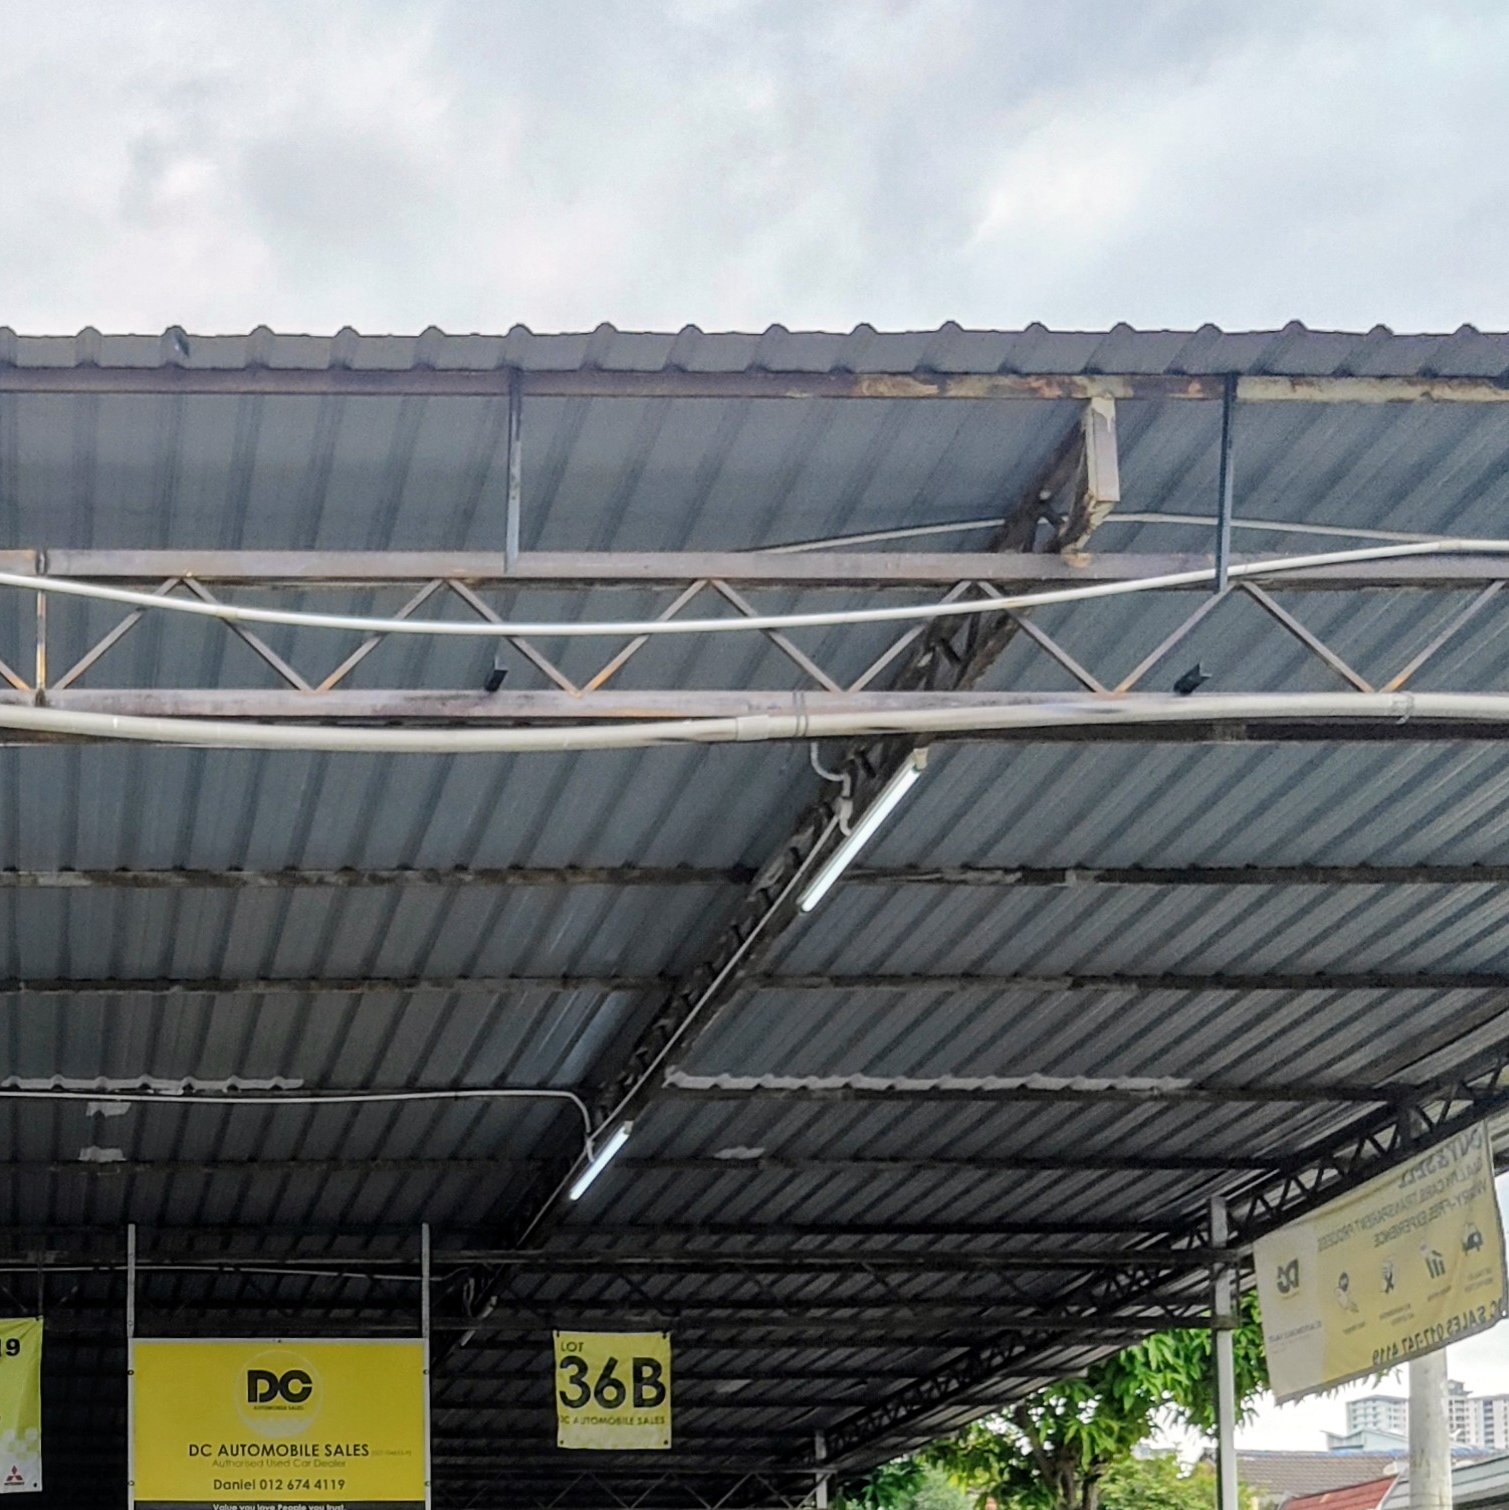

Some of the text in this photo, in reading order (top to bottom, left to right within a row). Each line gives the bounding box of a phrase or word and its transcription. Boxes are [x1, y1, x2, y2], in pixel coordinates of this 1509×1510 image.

[560, 1341, 585, 1352] LOT
[247, 1369, 313, 1403] DC
[559, 1355, 666, 1409] 36B
[189, 1444, 212, 1457] DC
[218, 1444, 319, 1457] AUTOMOBILE
[325, 1443, 369, 1457] SALES
[212, 1459, 346, 1468] Authorised Used Car Dealer
[214, 1479, 345, 1491] Daniel 012 674 4119
